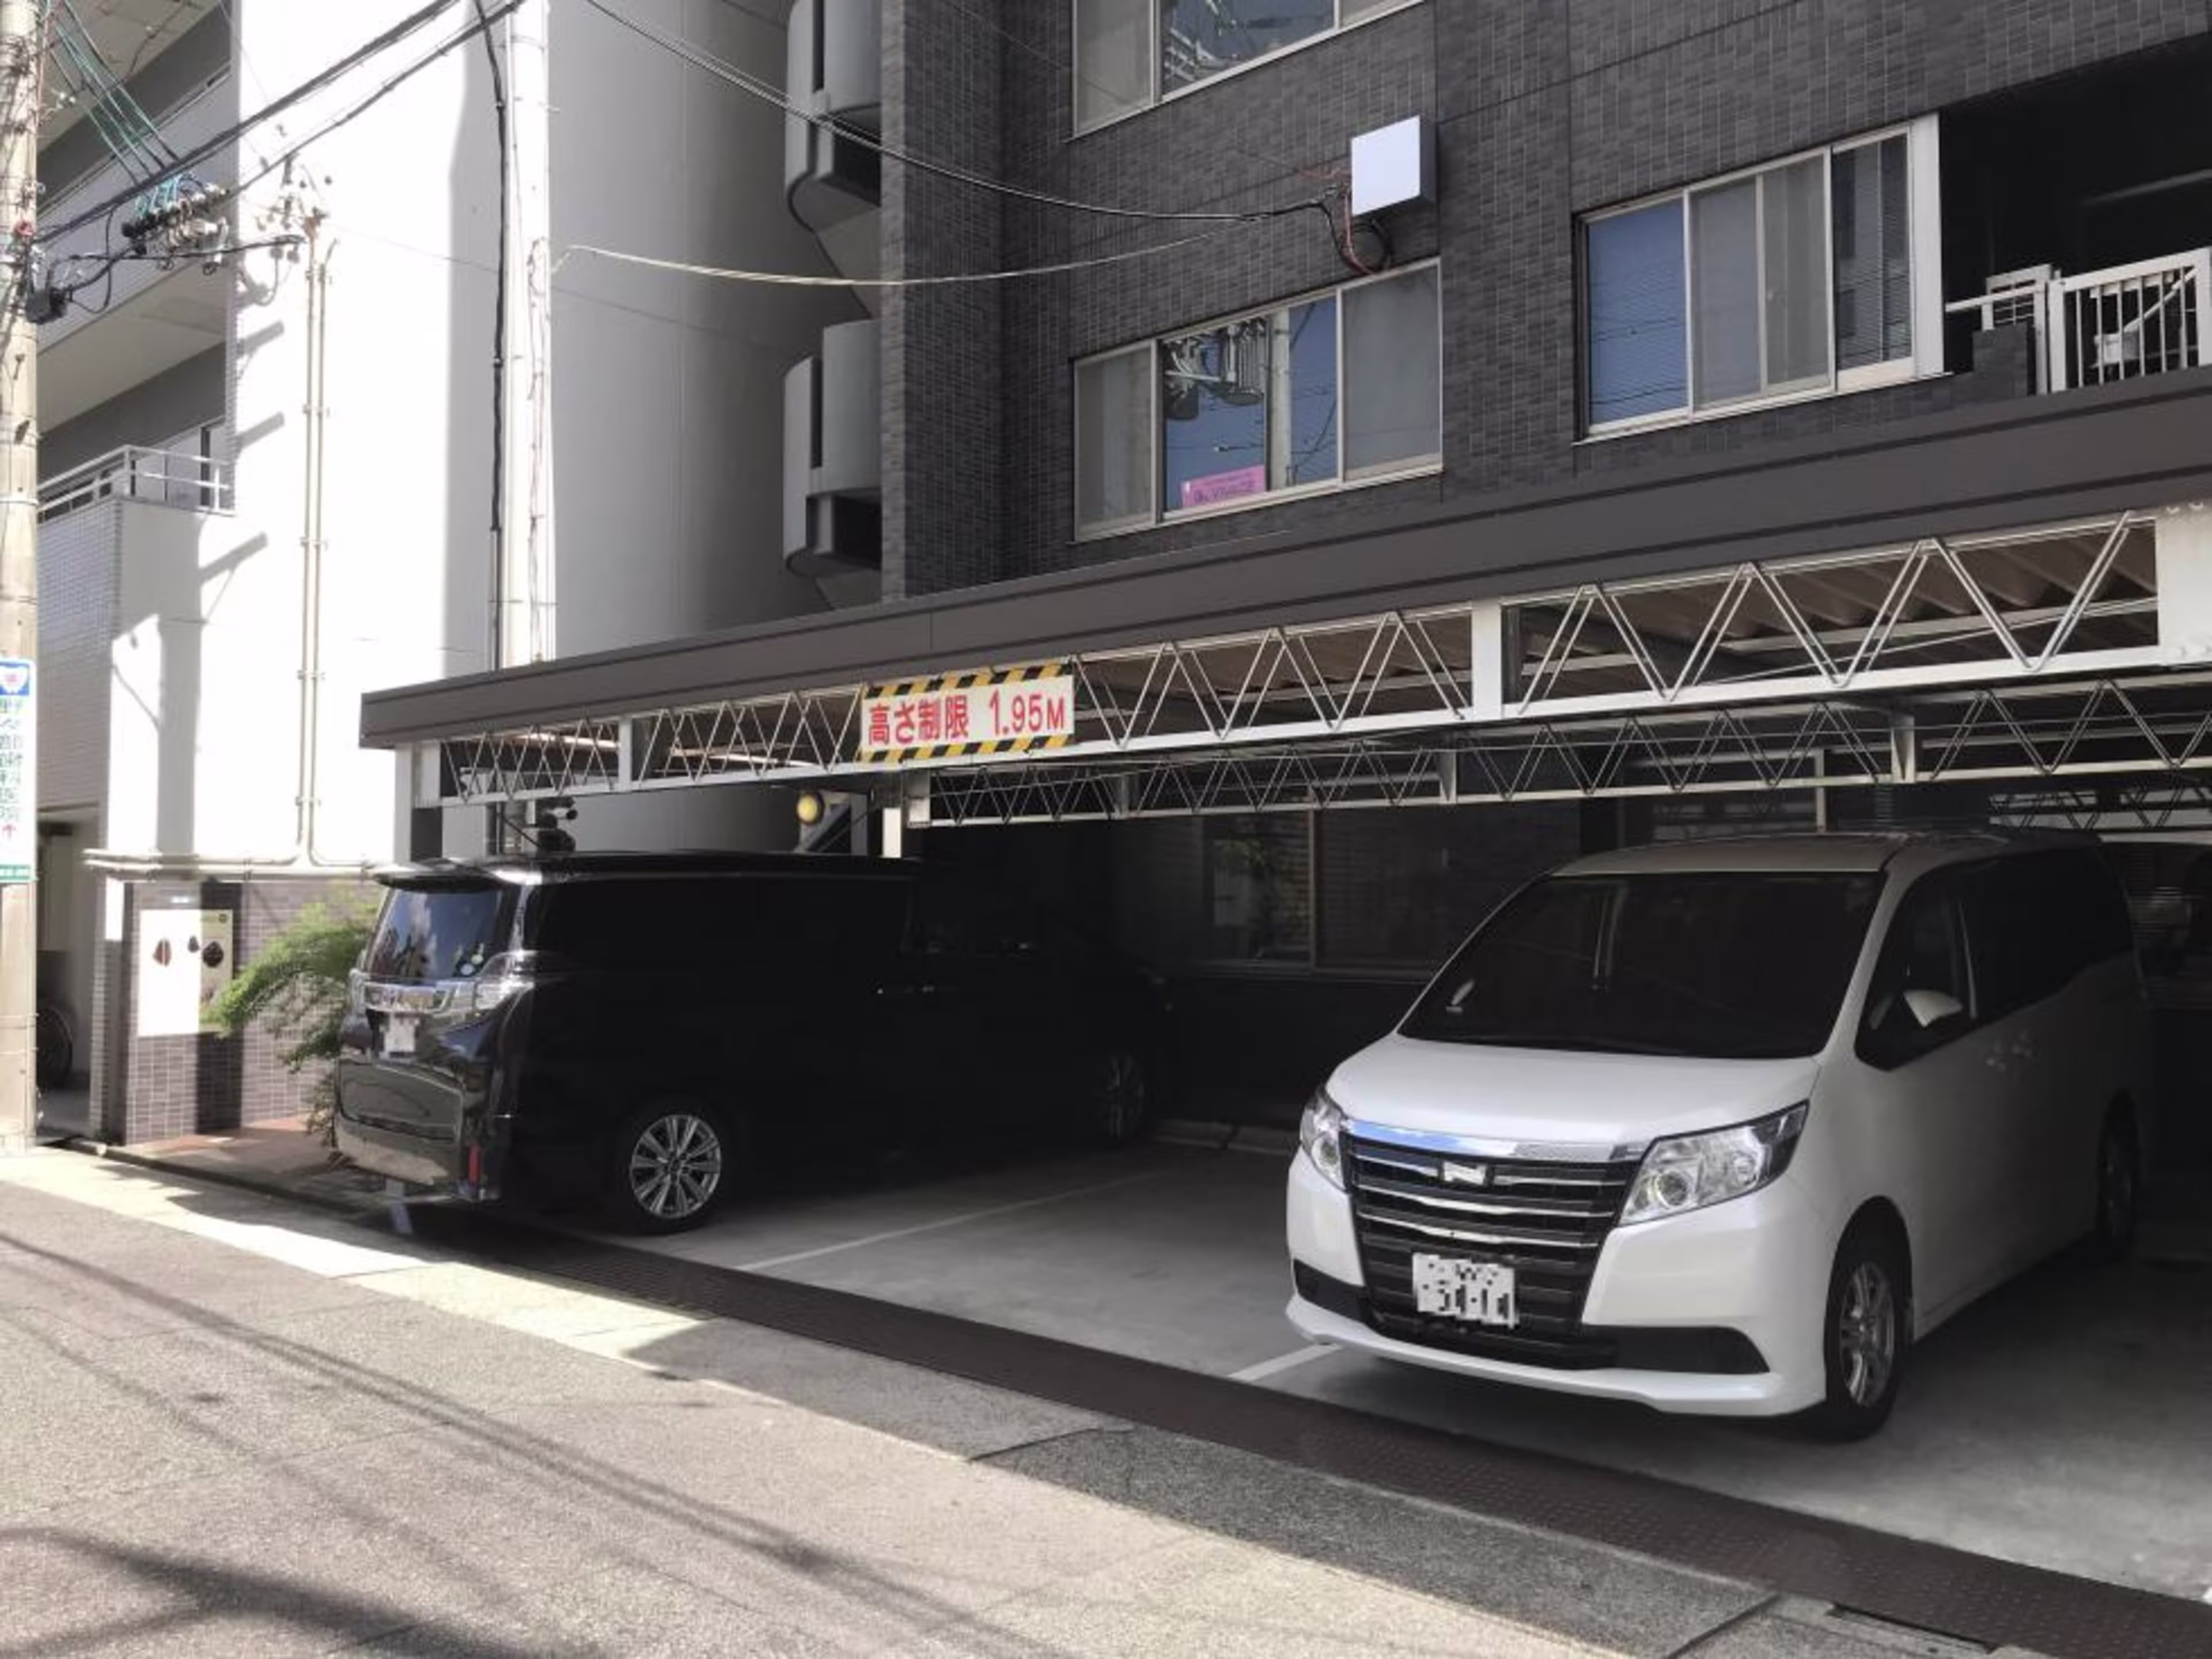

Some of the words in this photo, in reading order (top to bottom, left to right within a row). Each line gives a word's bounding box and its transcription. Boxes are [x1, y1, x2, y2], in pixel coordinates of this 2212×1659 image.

[868, 695, 969, 745] 高さ制限
[988, 690, 1065, 736] 1.95M
